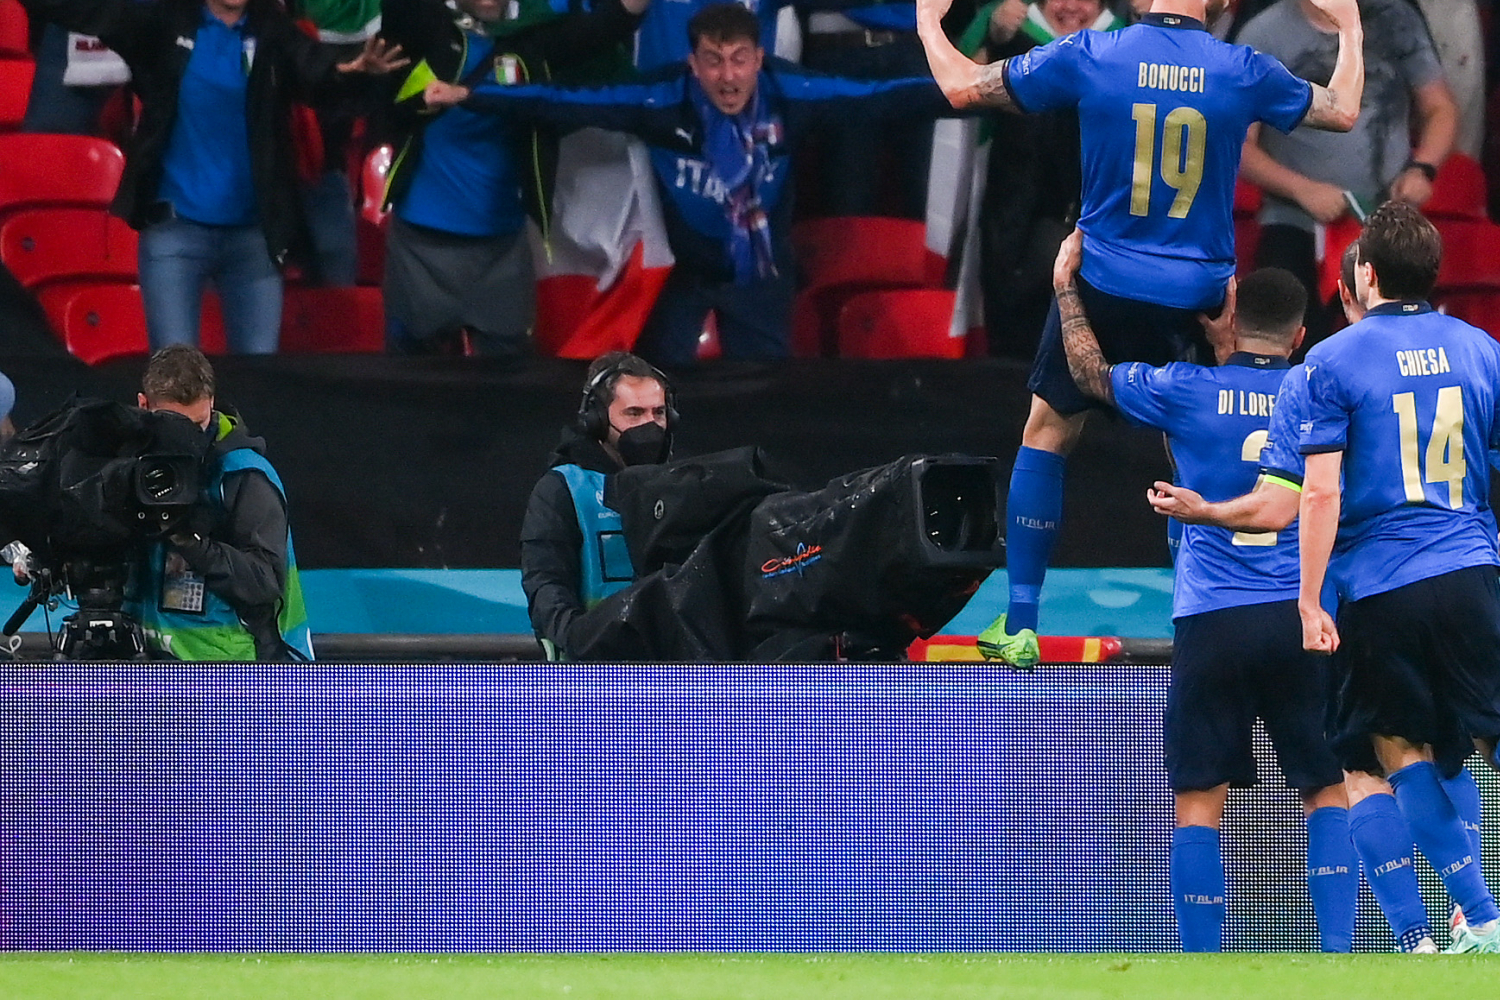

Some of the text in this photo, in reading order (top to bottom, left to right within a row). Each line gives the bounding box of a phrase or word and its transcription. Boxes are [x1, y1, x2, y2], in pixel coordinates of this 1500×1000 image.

[1137, 61, 1205, 94] BONUCCI
[1129, 102, 1208, 219] 19
[1396, 347, 1451, 377] CHIESA
[1217, 389, 1234, 415] DI
[1392, 385, 1467, 510] 14
[1016, 515, 1055, 530] ITALIA
[1374, 856, 1411, 877] ITALIA
[1184, 894, 1224, 905] ITALIA
